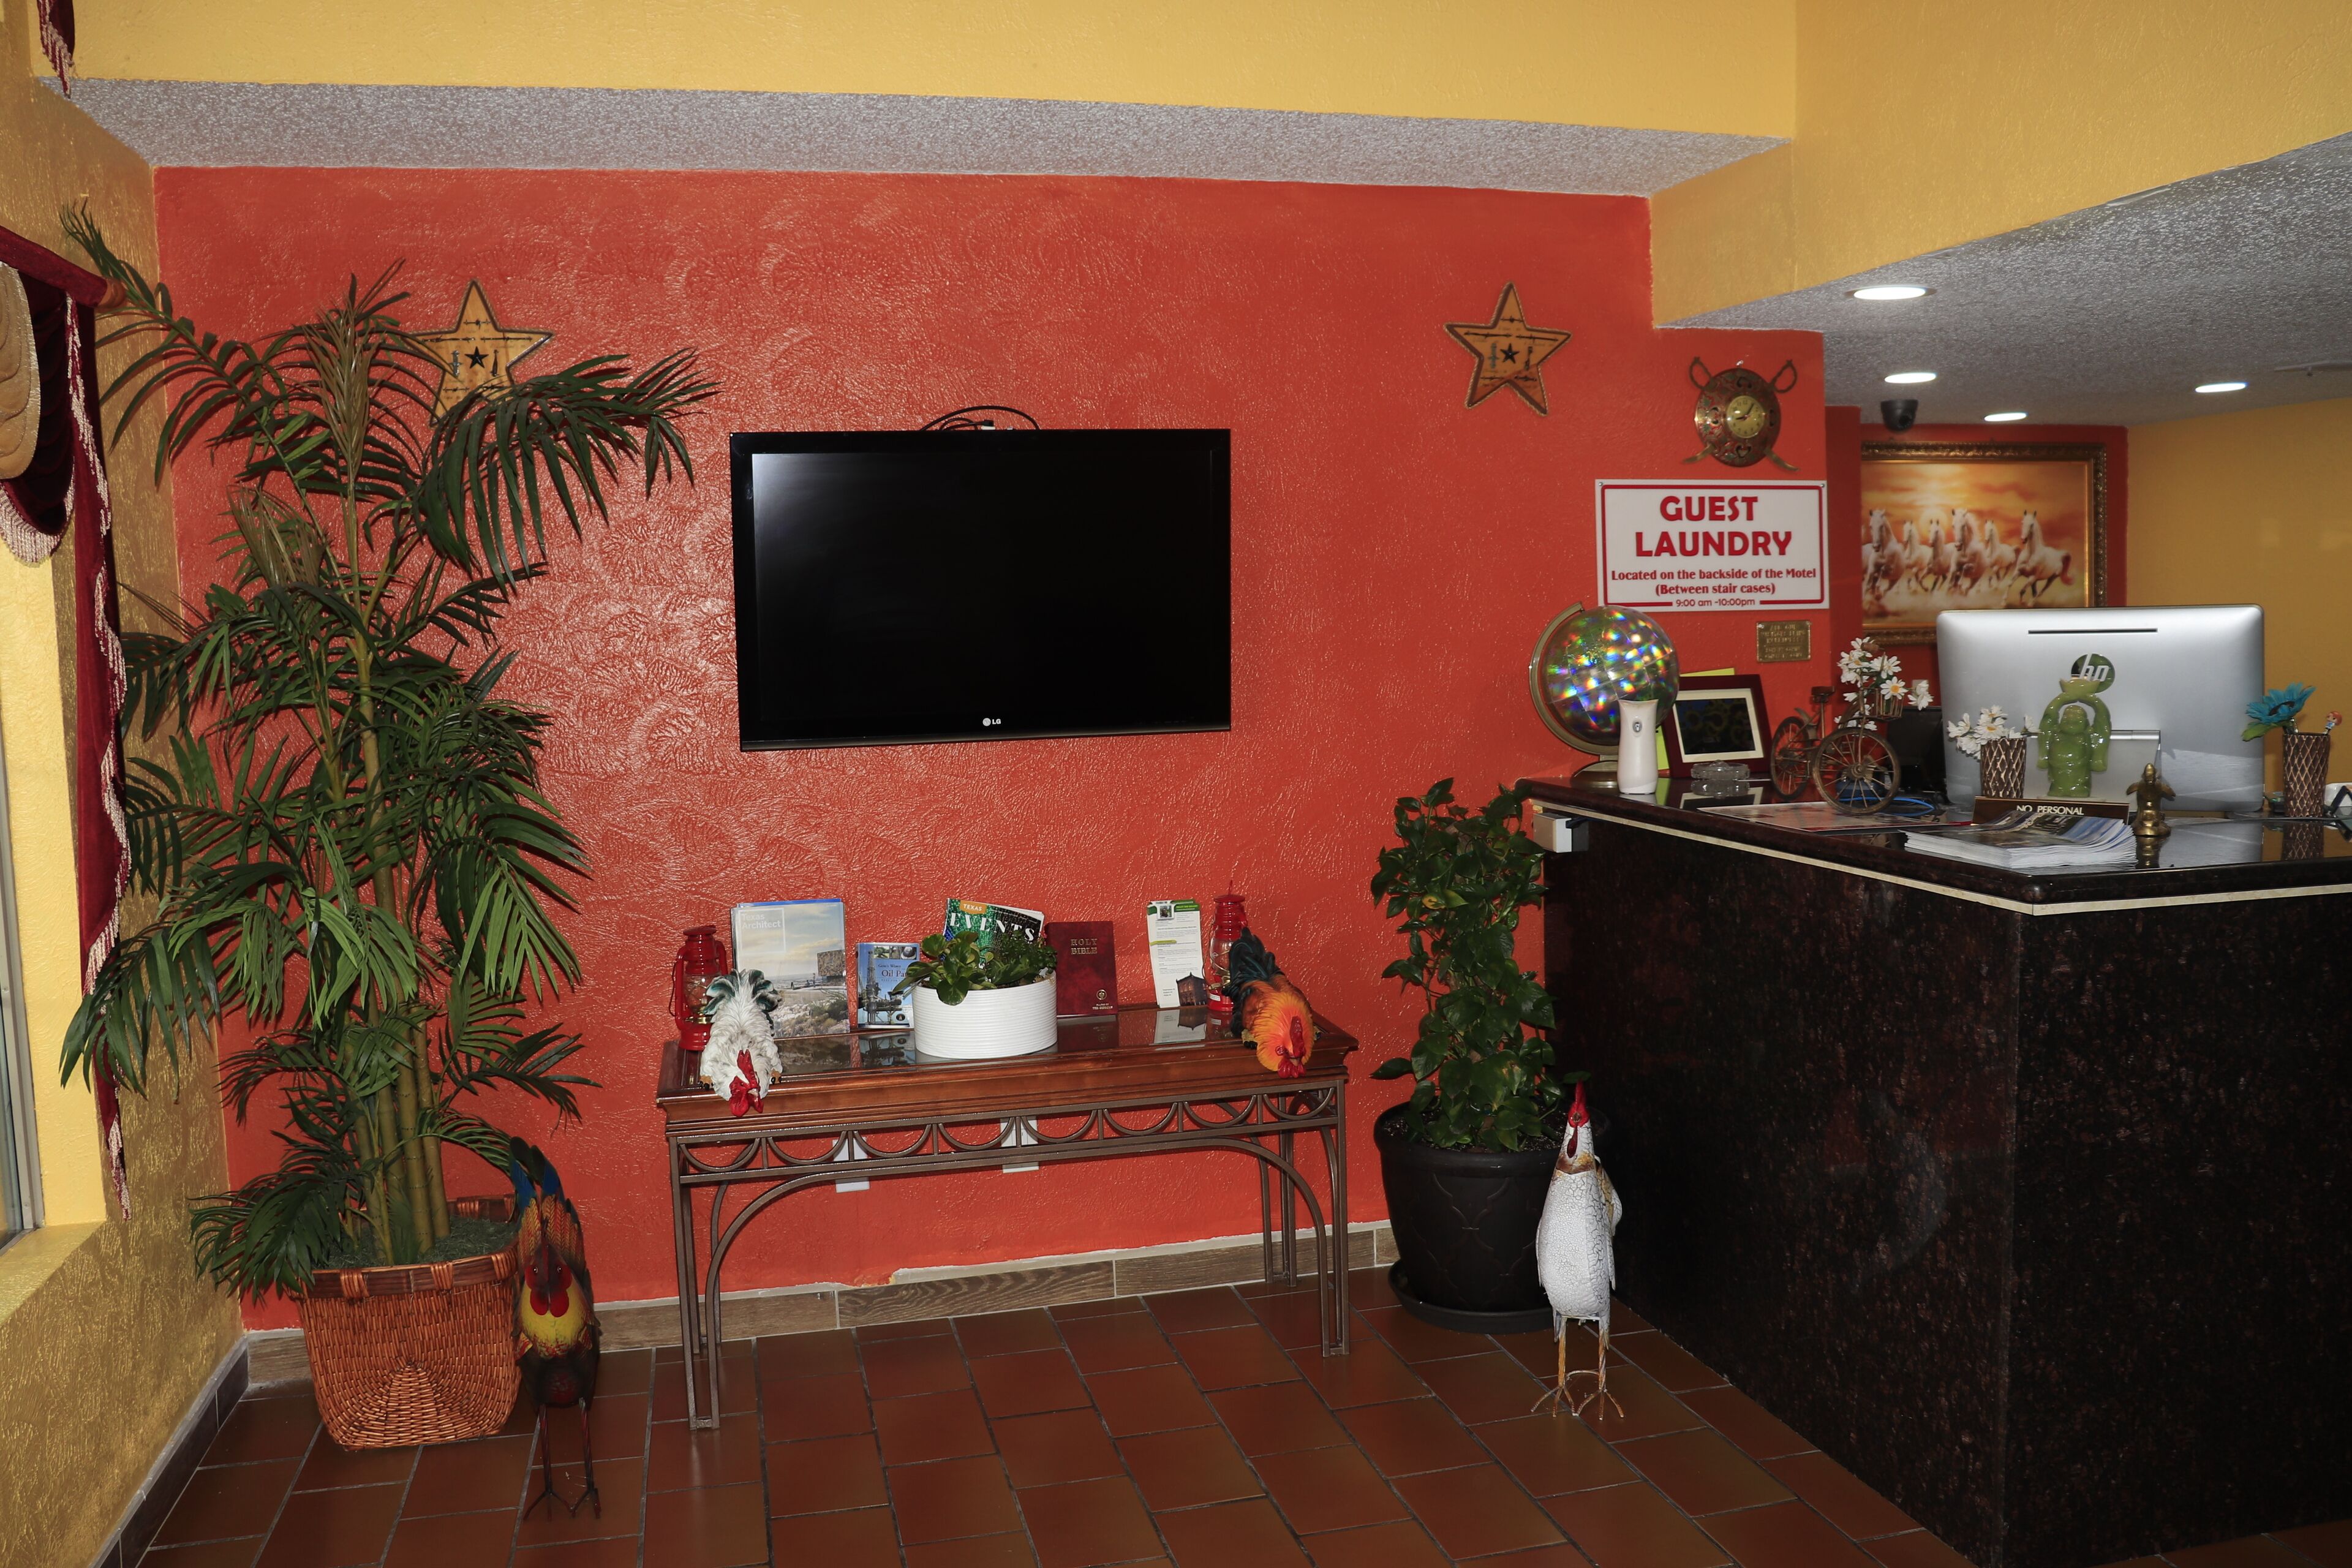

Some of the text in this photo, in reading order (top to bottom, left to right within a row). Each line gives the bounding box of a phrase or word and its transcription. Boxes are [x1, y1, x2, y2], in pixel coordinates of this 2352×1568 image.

[1660, 496, 1758, 521] GUEST
[1635, 531, 1792, 557] LAUNDRY
[1611, 570, 1657, 581] Located
[1677, 570, 1696, 579] the
[1699, 568, 1748, 579] backside
[1751, 568, 1763, 579] of
[1765, 568, 1784, 579] the
[1786, 568, 1817, 578] Motel
[1656, 582, 1776, 597] (Between stair cases)
[2079, 653, 2109, 682] hp
[2037, 805, 2084, 815] PERSONAL
[742, 920, 782, 929] Architect
[949, 912, 1035, 941] EVENTS
